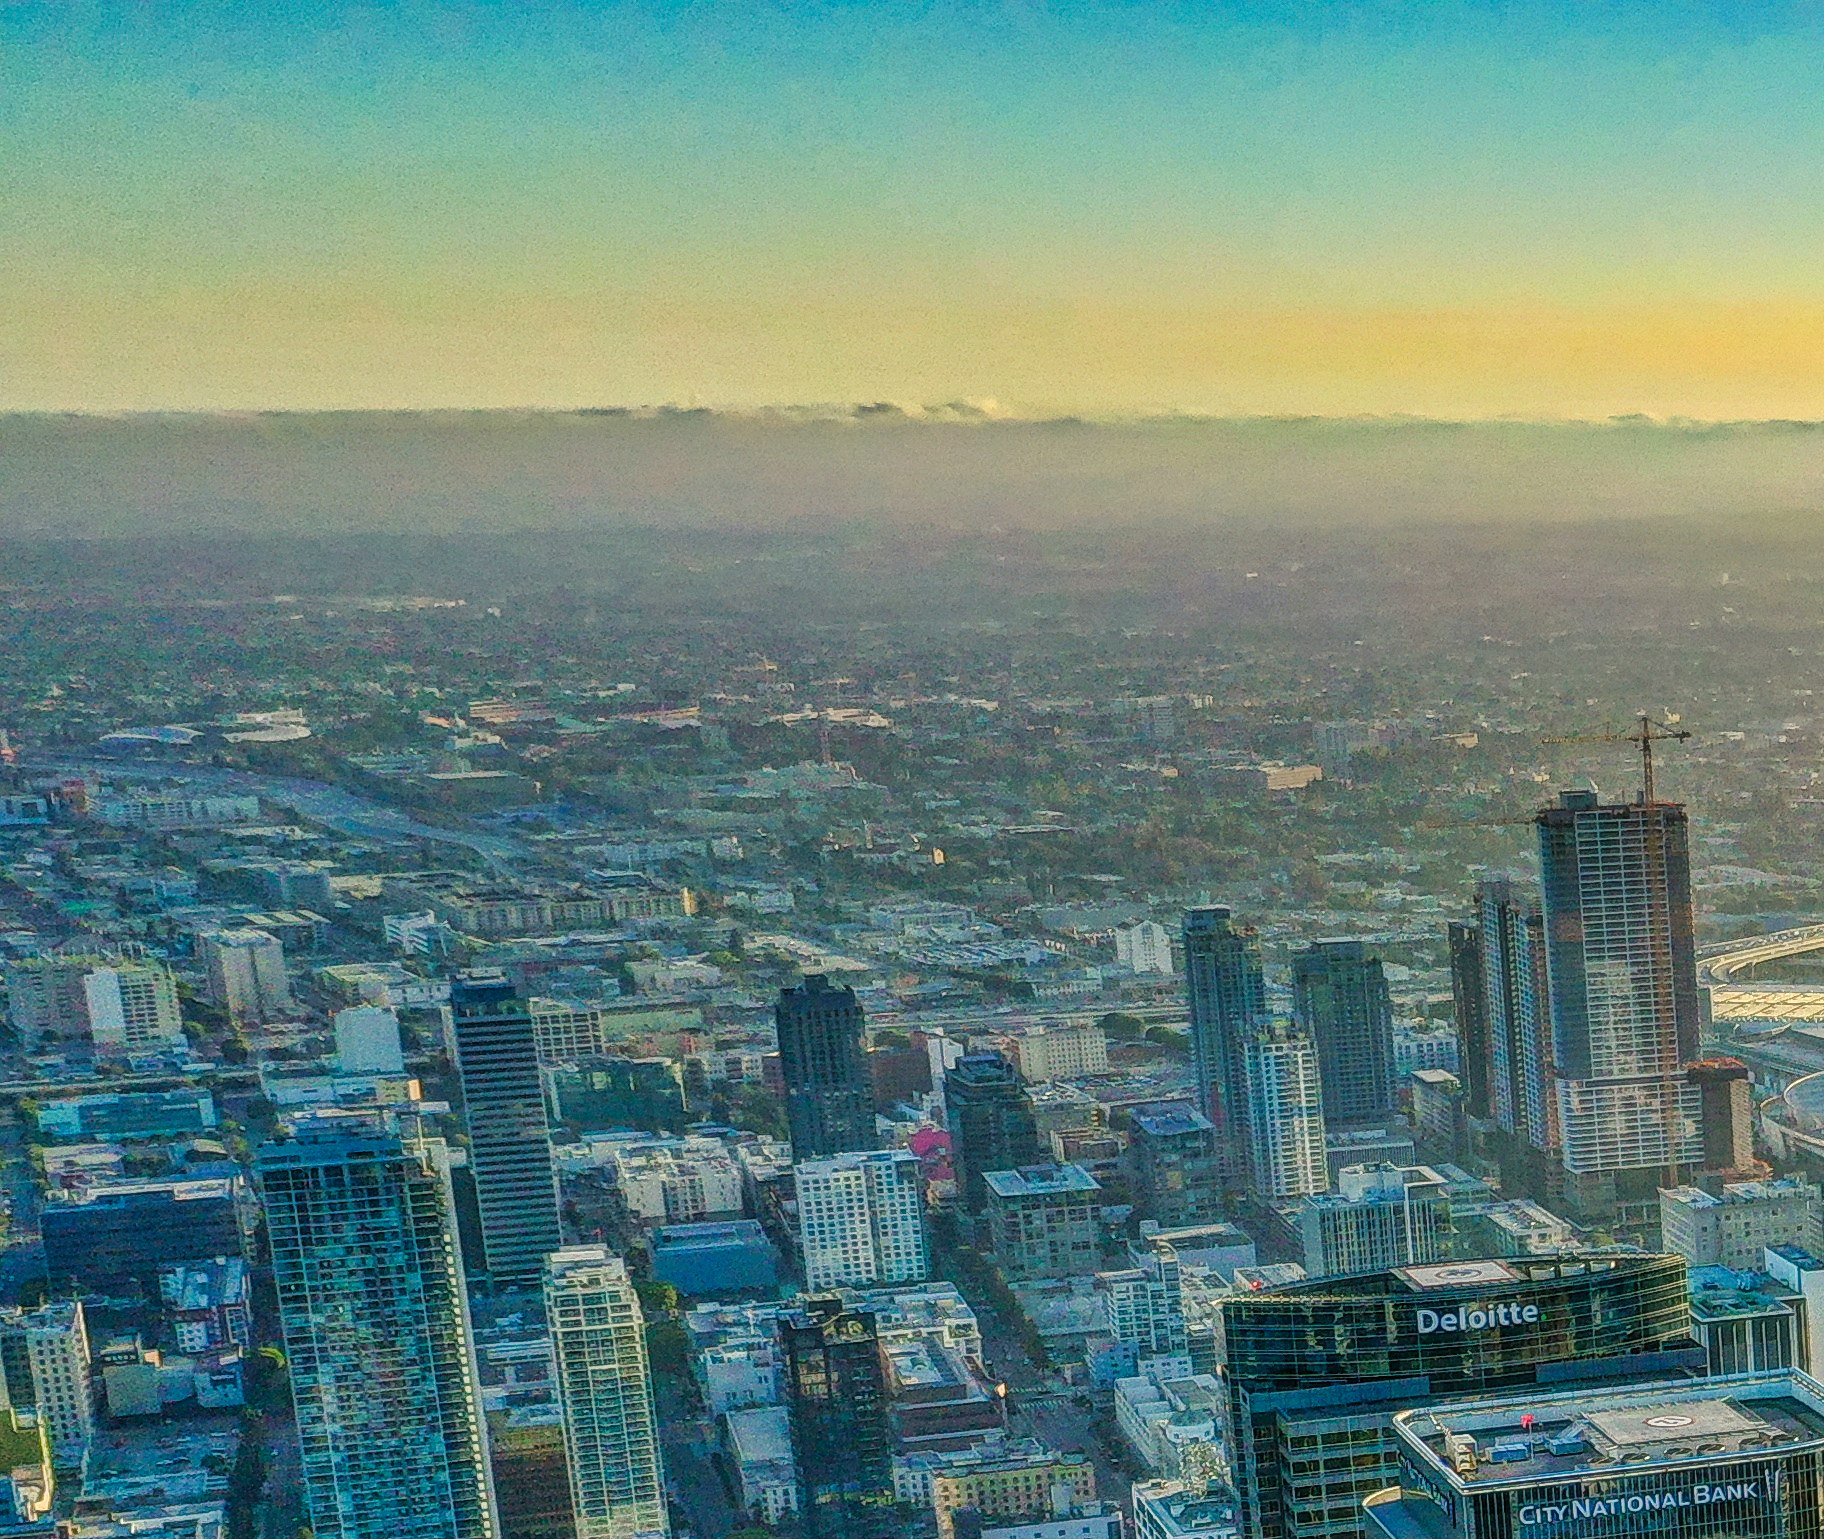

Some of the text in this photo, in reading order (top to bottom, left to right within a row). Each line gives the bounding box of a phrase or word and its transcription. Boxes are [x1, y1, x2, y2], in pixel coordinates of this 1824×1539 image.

[1519, 1481, 1758, 1525] CITY NATIONAL BANK
